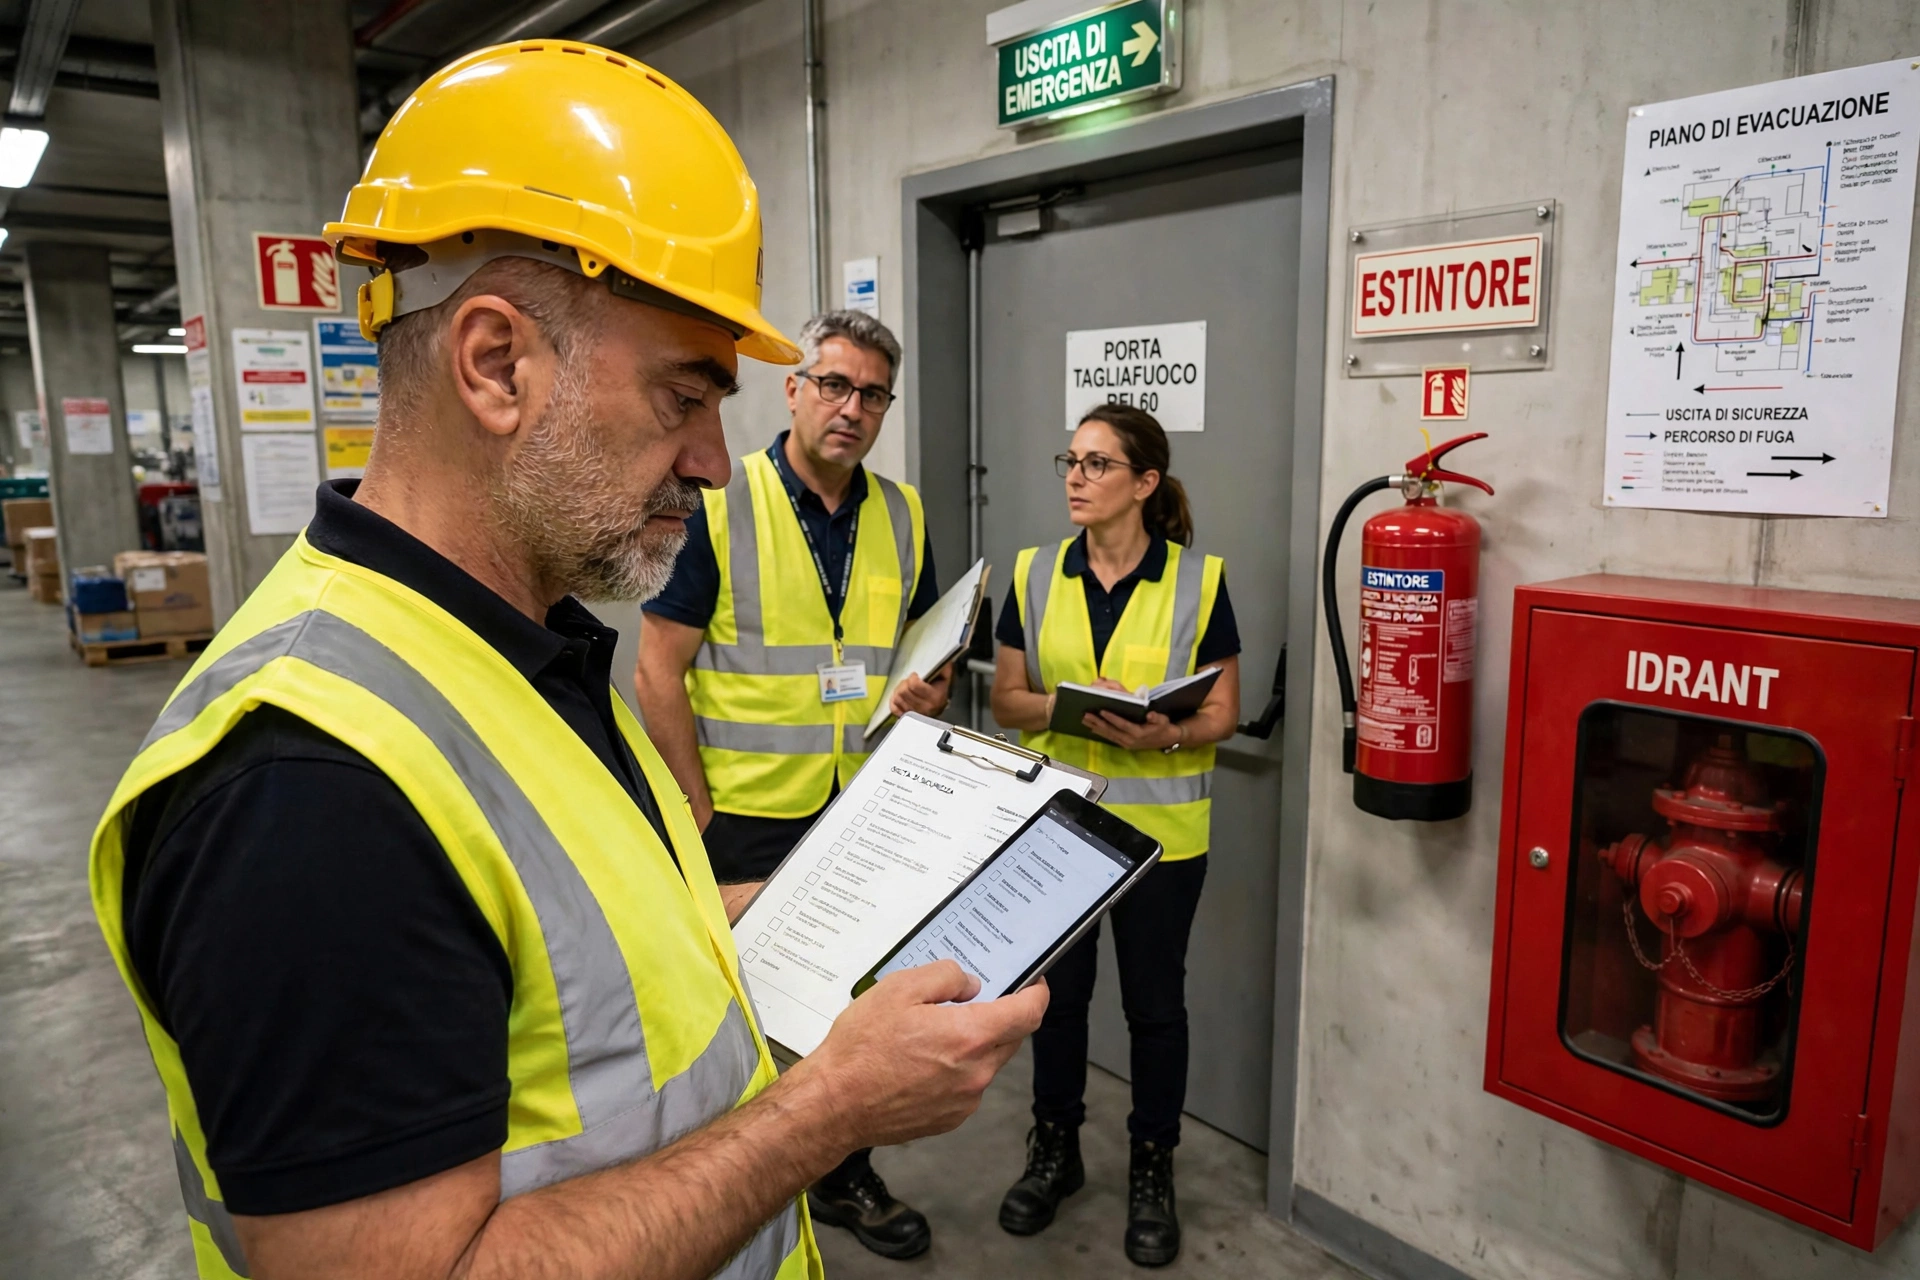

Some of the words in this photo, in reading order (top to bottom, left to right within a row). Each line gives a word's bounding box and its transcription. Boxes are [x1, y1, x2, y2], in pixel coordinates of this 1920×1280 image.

[1015, 30, 1082, 78] USCITA
[1086, 21, 1107, 58] DI
[1005, 55, 1122, 116] EMERGENZA
[1649, 122, 1705, 149] PIANO
[1712, 117, 1730, 139] DI
[1736, 92, 1890, 135] EVACUAZIONE
[1361, 256, 1532, 317] ESTINTORE
[1104, 338, 1162, 361] PORTA
[1074, 363, 1197, 388] TAGLIAFUOCO
[1140, 392, 1158, 412] 60
[1666, 408, 1711, 421] USCITA
[1715, 408, 1729, 420] DI
[1731, 407, 1808, 420] SICUREZZA
[1664, 431, 1735, 444] PERCORSO
[1739, 430, 1752, 443] DI
[1756, 430, 1795, 443] FUGA
[1367, 572, 1429, 588] ESTINTORE
[1626, 650, 1780, 710] IDRANT
